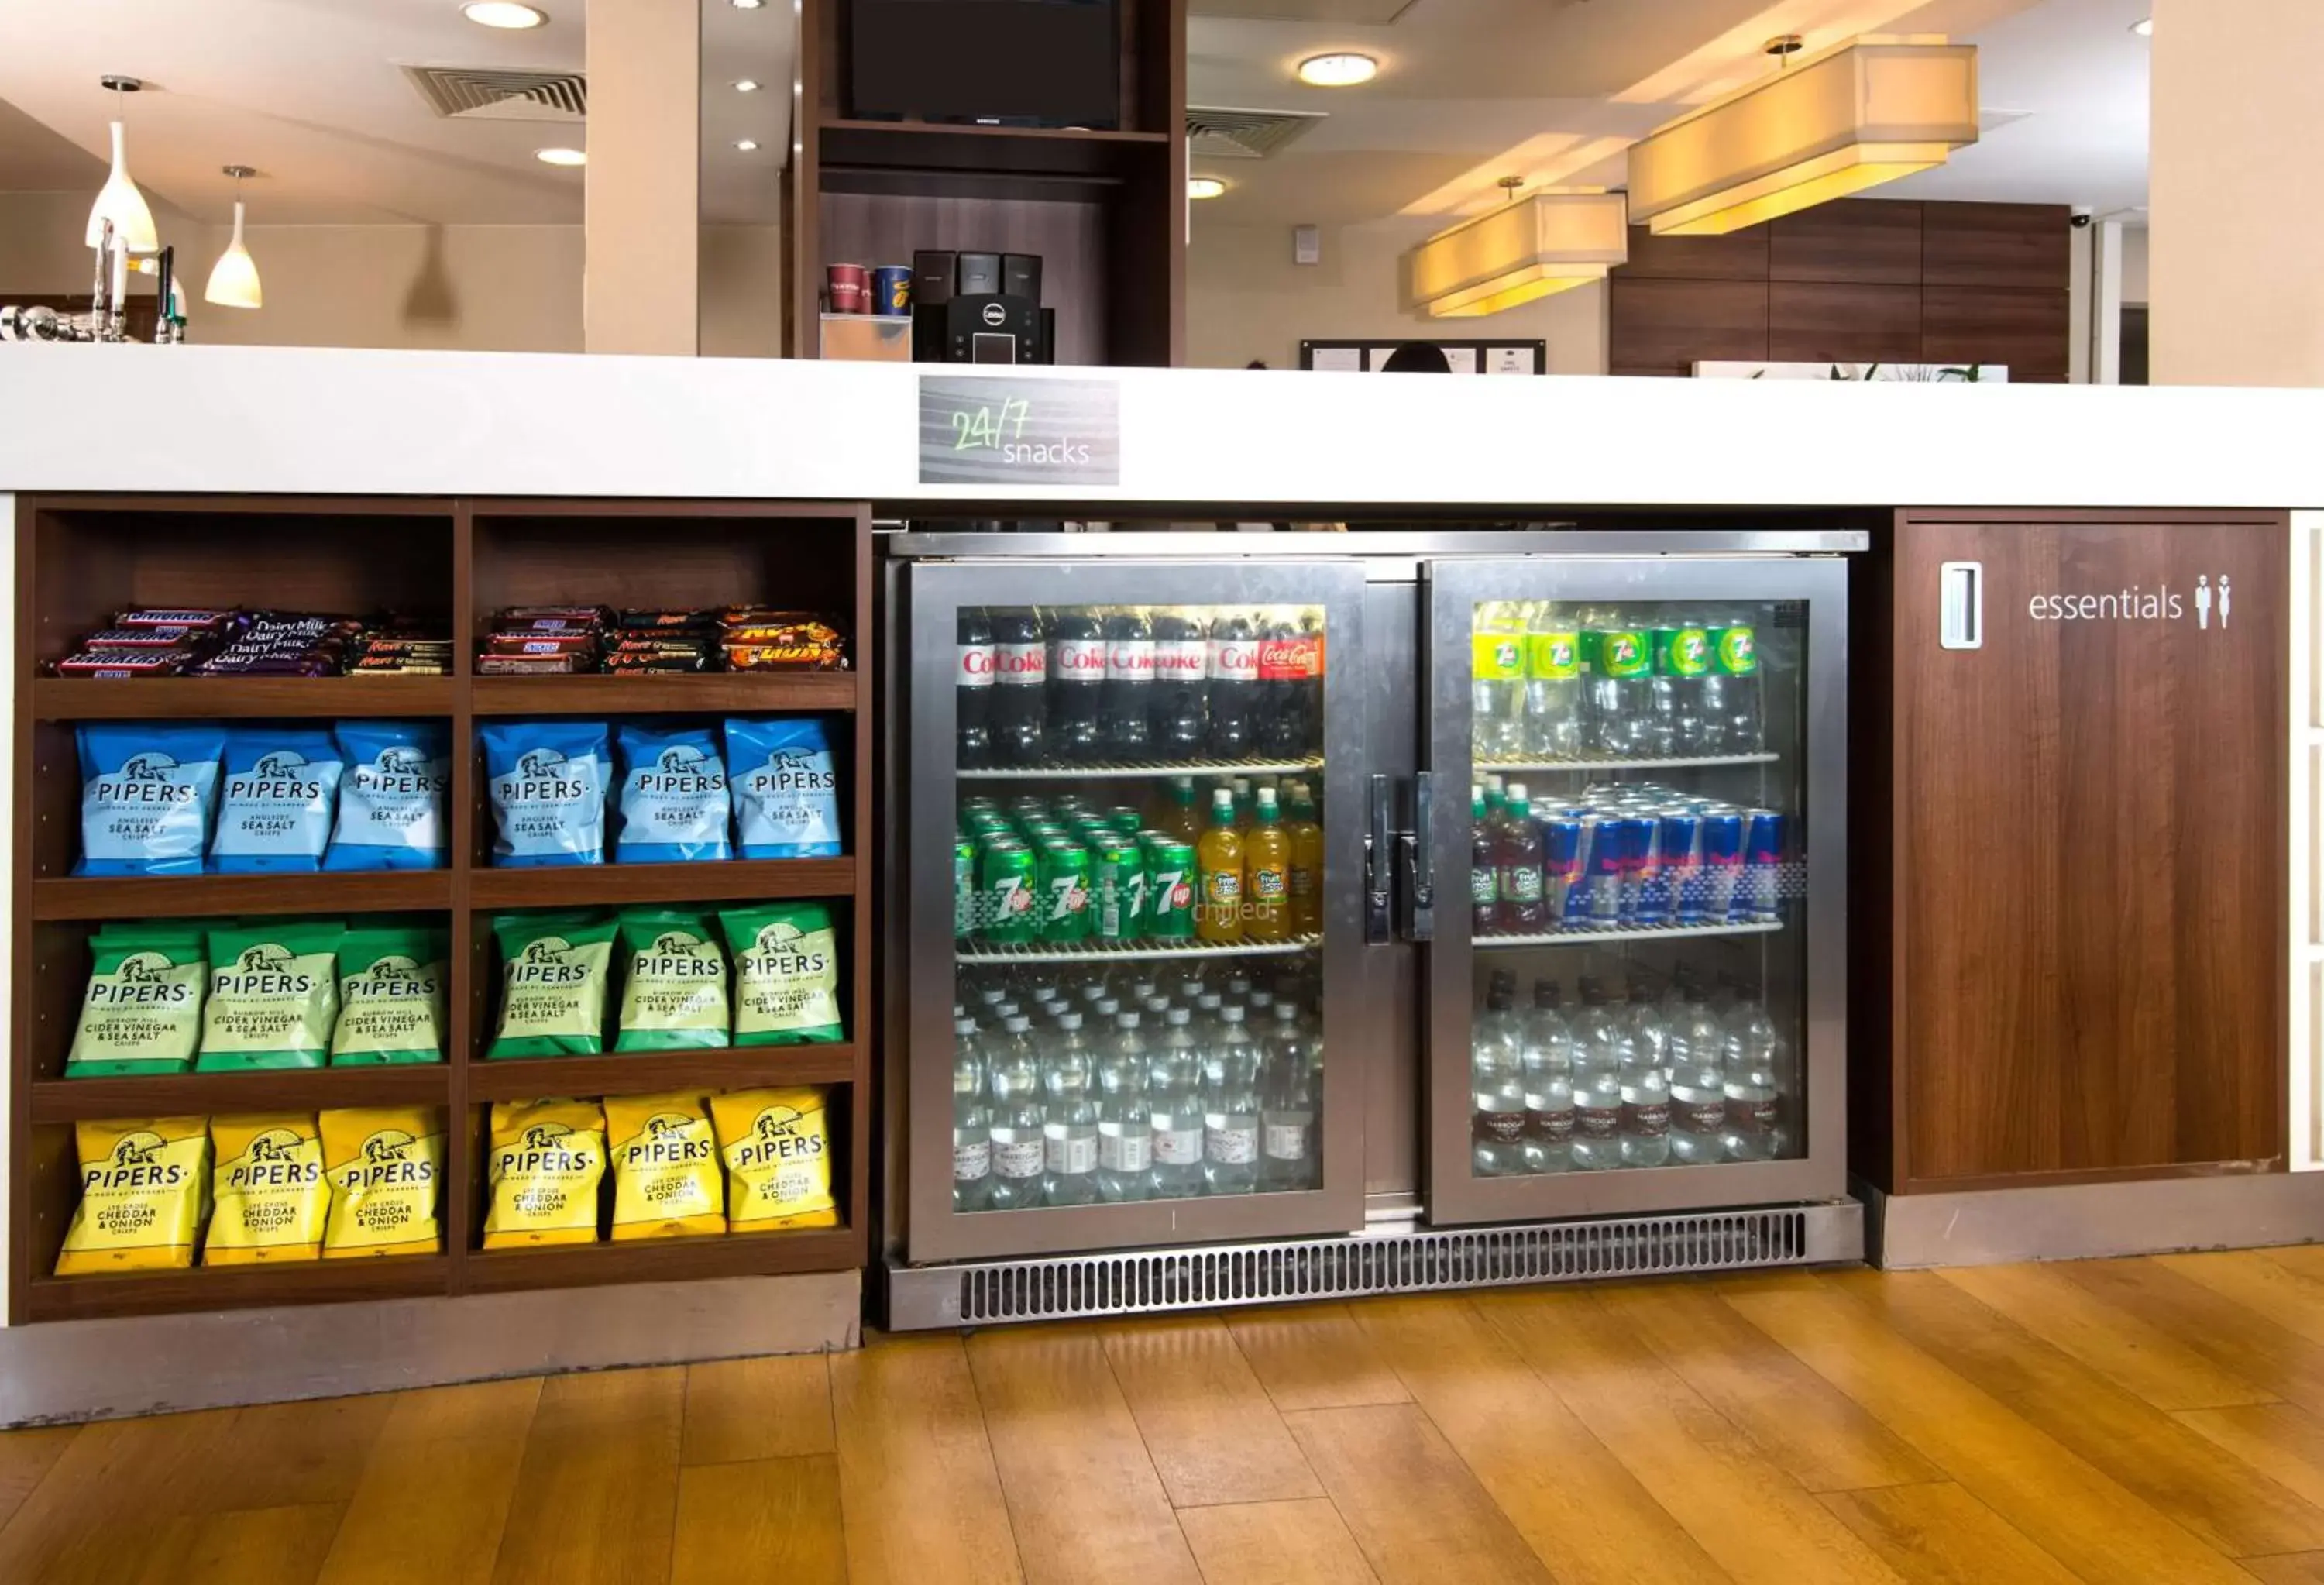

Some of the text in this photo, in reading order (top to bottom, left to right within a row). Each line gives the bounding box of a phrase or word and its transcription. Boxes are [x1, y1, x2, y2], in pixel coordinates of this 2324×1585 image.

[953, 396, 1032, 451] 24/7
[1003, 438, 1089, 464] snacks
[2029, 584, 2183, 620] essentials
[963, 652, 995, 674] Co
[230, 782, 320, 799] PIPERS
[356, 775, 445, 792] PIPERS
[502, 780, 582, 800] PIPERS
[641, 775, 723, 792] PIPERS
[755, 772, 835, 792] PIPERS
[98, 783, 191, 802] PIPERS
[109, 824, 131, 833] SEA
[241, 821, 295, 830] SEA SALT
[514, 822, 565, 832] SEA SALT
[636, 958, 720, 976] PIPERS
[743, 954, 823, 976] PIPERS
[216, 975, 309, 994] PIPERS
[347, 978, 436, 995] PIPERS
[91, 984, 187, 1003] PIPERS
[510, 1001, 579, 1011] DER VINEGAR
[518, 1010, 538, 1019] SEA
[85, 1023, 177, 1033] CIDER VINEGAR
[214, 1014, 304, 1025] CIDER VINEGAR
[260, 1023, 289, 1033] SALT
[345, 1014, 430, 1027] CIDER VINEGAR
[366, 1024, 387, 1033] SEA
[388, 1023, 416, 1032] SALT
[108, 1033, 129, 1041] SEA
[132, 1032, 160, 1040] SALT
[628, 1140, 710, 1164] PIPERS
[741, 1134, 822, 1166] PIPERS
[501, 1152, 586, 1172] PIPERS
[86, 1164, 180, 1188] PIPERS
[231, 1163, 318, 1187] PIPERS
[347, 1161, 432, 1188] PIPERS
[514, 1194, 566, 1203] CHEDDAR
[525, 1202, 564, 1211] ONION
[97, 1209, 156, 1220] CHEDDAR
[242, 1207, 297, 1219] CHEDDAR
[356, 1205, 411, 1217] CHEDDAR
[109, 1218, 153, 1229] ONION
[251, 1215, 294, 1226] ONION
[368, 1215, 409, 1226] ONION
